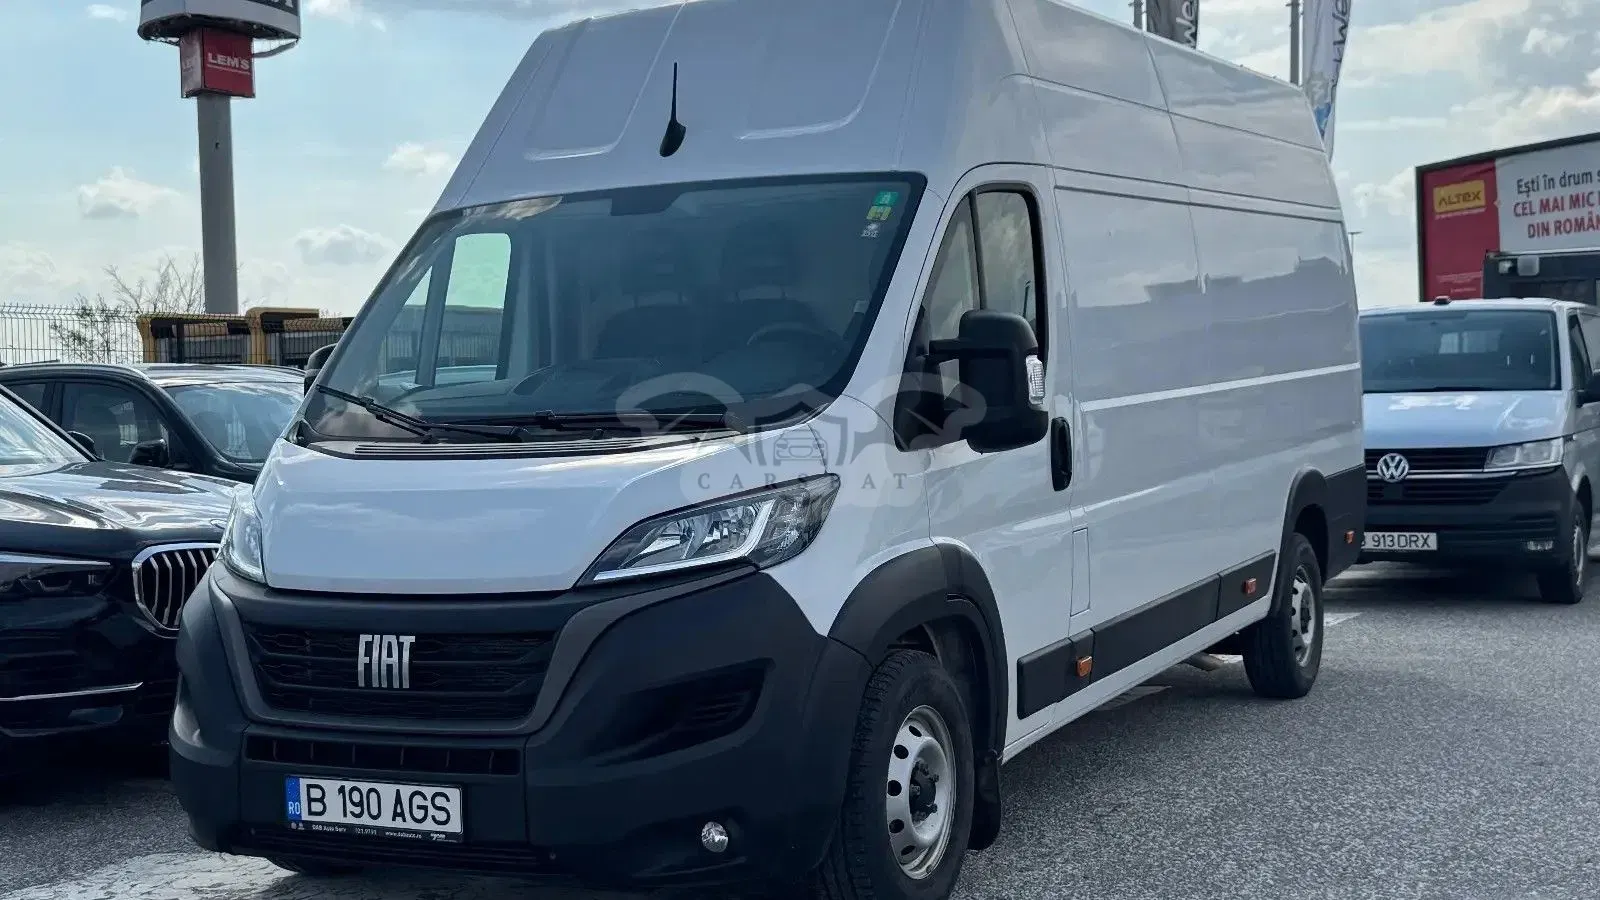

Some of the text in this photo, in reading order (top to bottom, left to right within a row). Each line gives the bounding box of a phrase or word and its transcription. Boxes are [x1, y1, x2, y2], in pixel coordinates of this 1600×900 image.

[1559, 170, 1593, 188] drum
[1513, 201, 1536, 217] CEL
[1539, 196, 1564, 214] MAI
[1569, 191, 1594, 210] MIC
[1527, 221, 1550, 239] DIN
[358, 634, 416, 688] FIAT
[288, 801, 301, 815] RO
[306, 783, 451, 826] B 190 AGS
